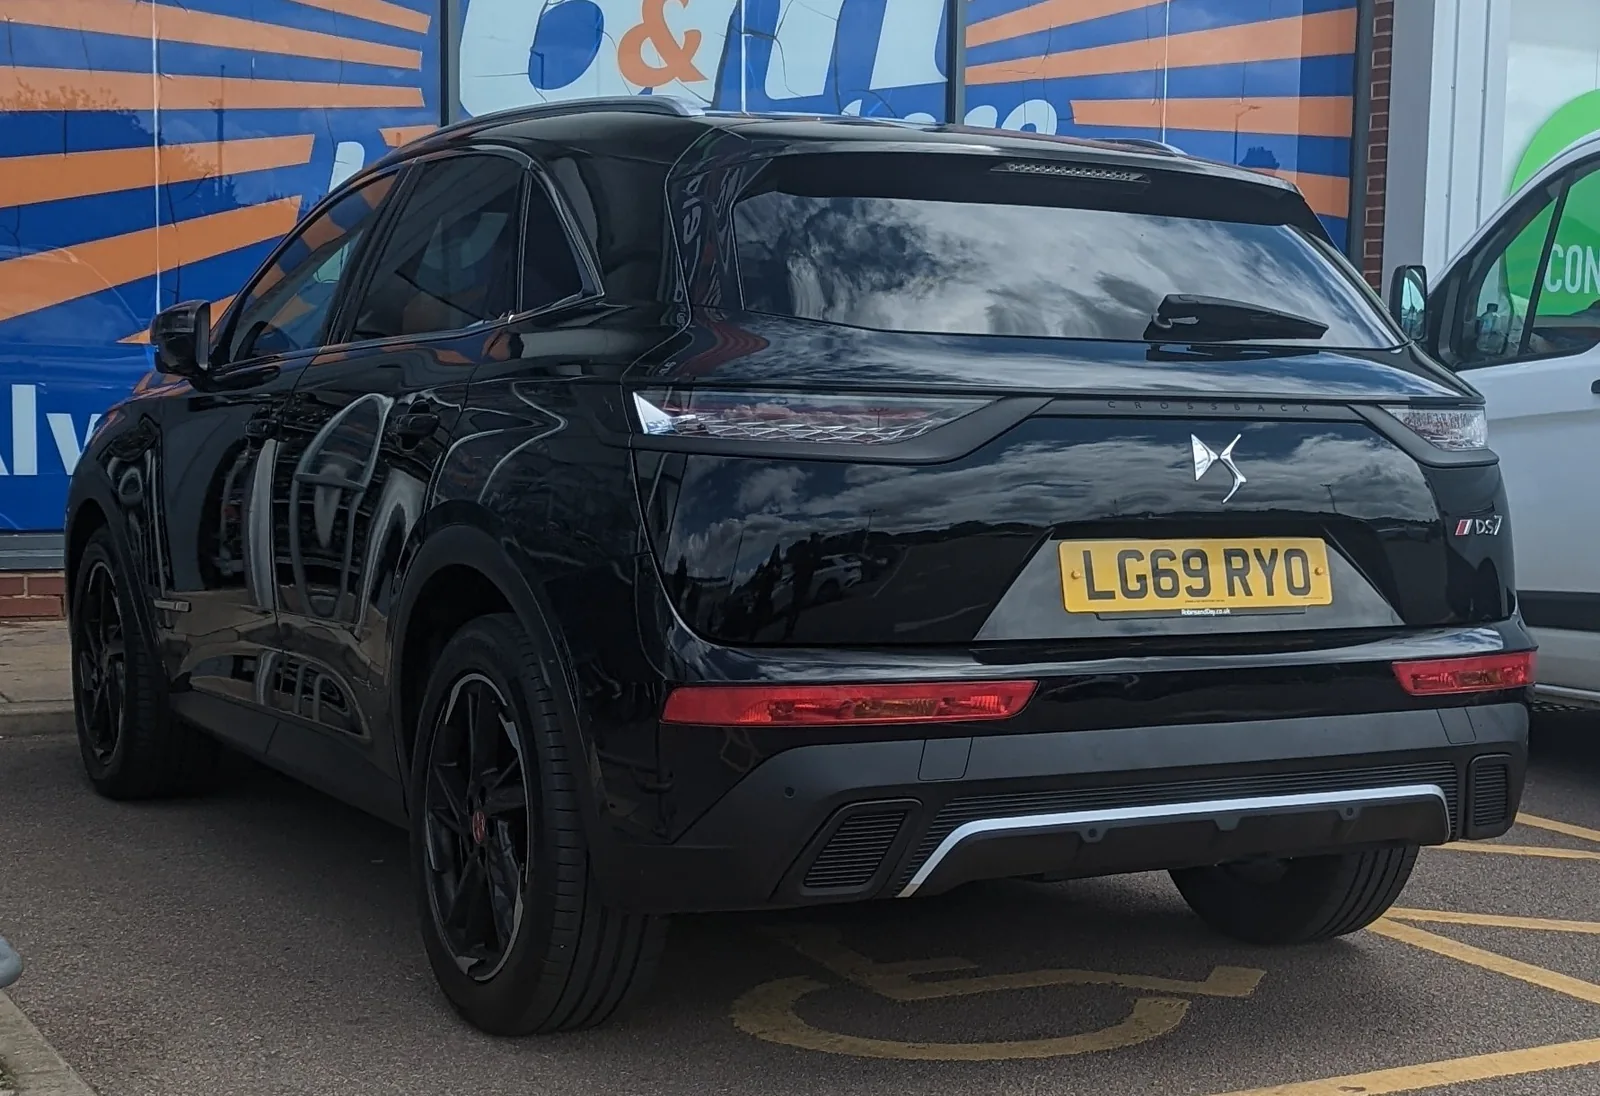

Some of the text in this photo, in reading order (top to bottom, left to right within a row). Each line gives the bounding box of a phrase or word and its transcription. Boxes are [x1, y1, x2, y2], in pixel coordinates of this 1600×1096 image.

[1107, 400, 1310, 413] CROSSBACK
[1082, 548, 1312, 600] LG69 RYO
